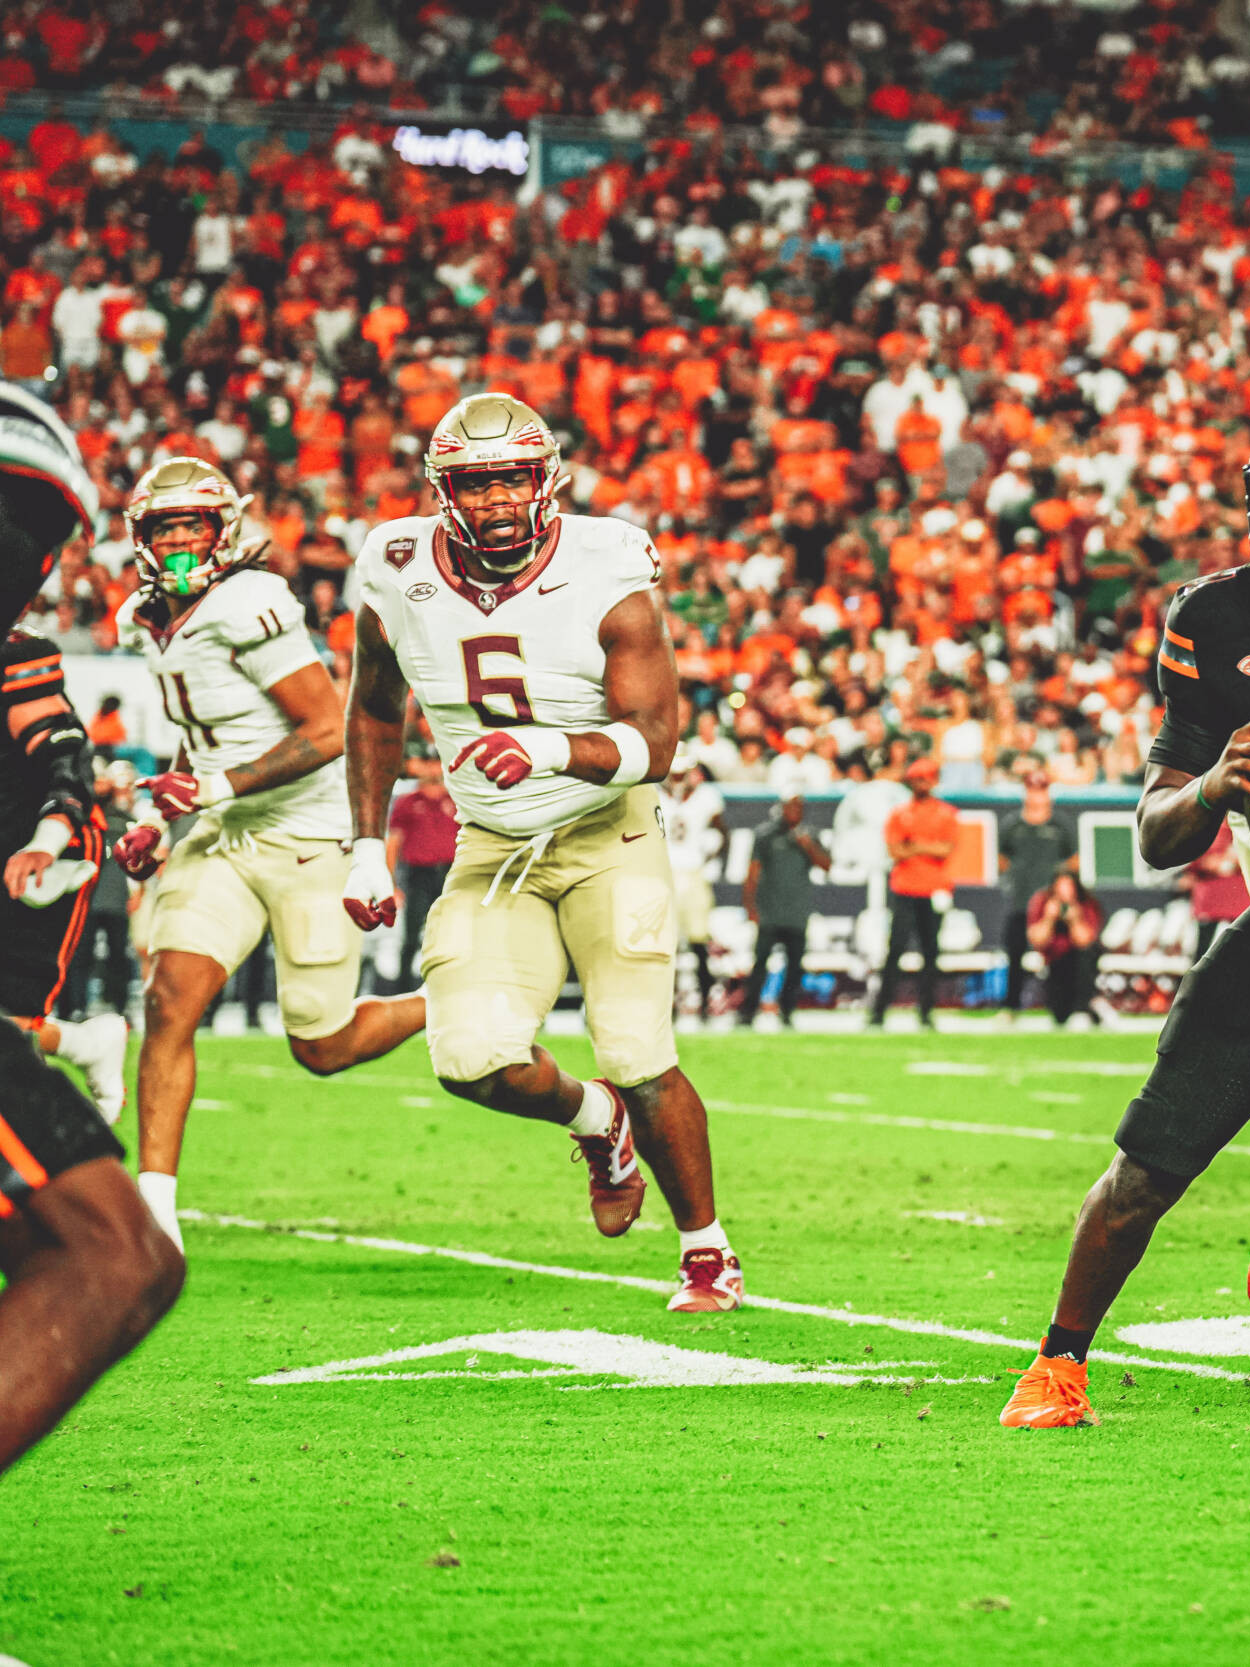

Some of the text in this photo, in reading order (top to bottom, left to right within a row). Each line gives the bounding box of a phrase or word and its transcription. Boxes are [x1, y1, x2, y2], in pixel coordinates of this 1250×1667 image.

[257, 608, 283, 639] 11
[157, 672, 221, 751] 11
[458, 632, 537, 729] 6
